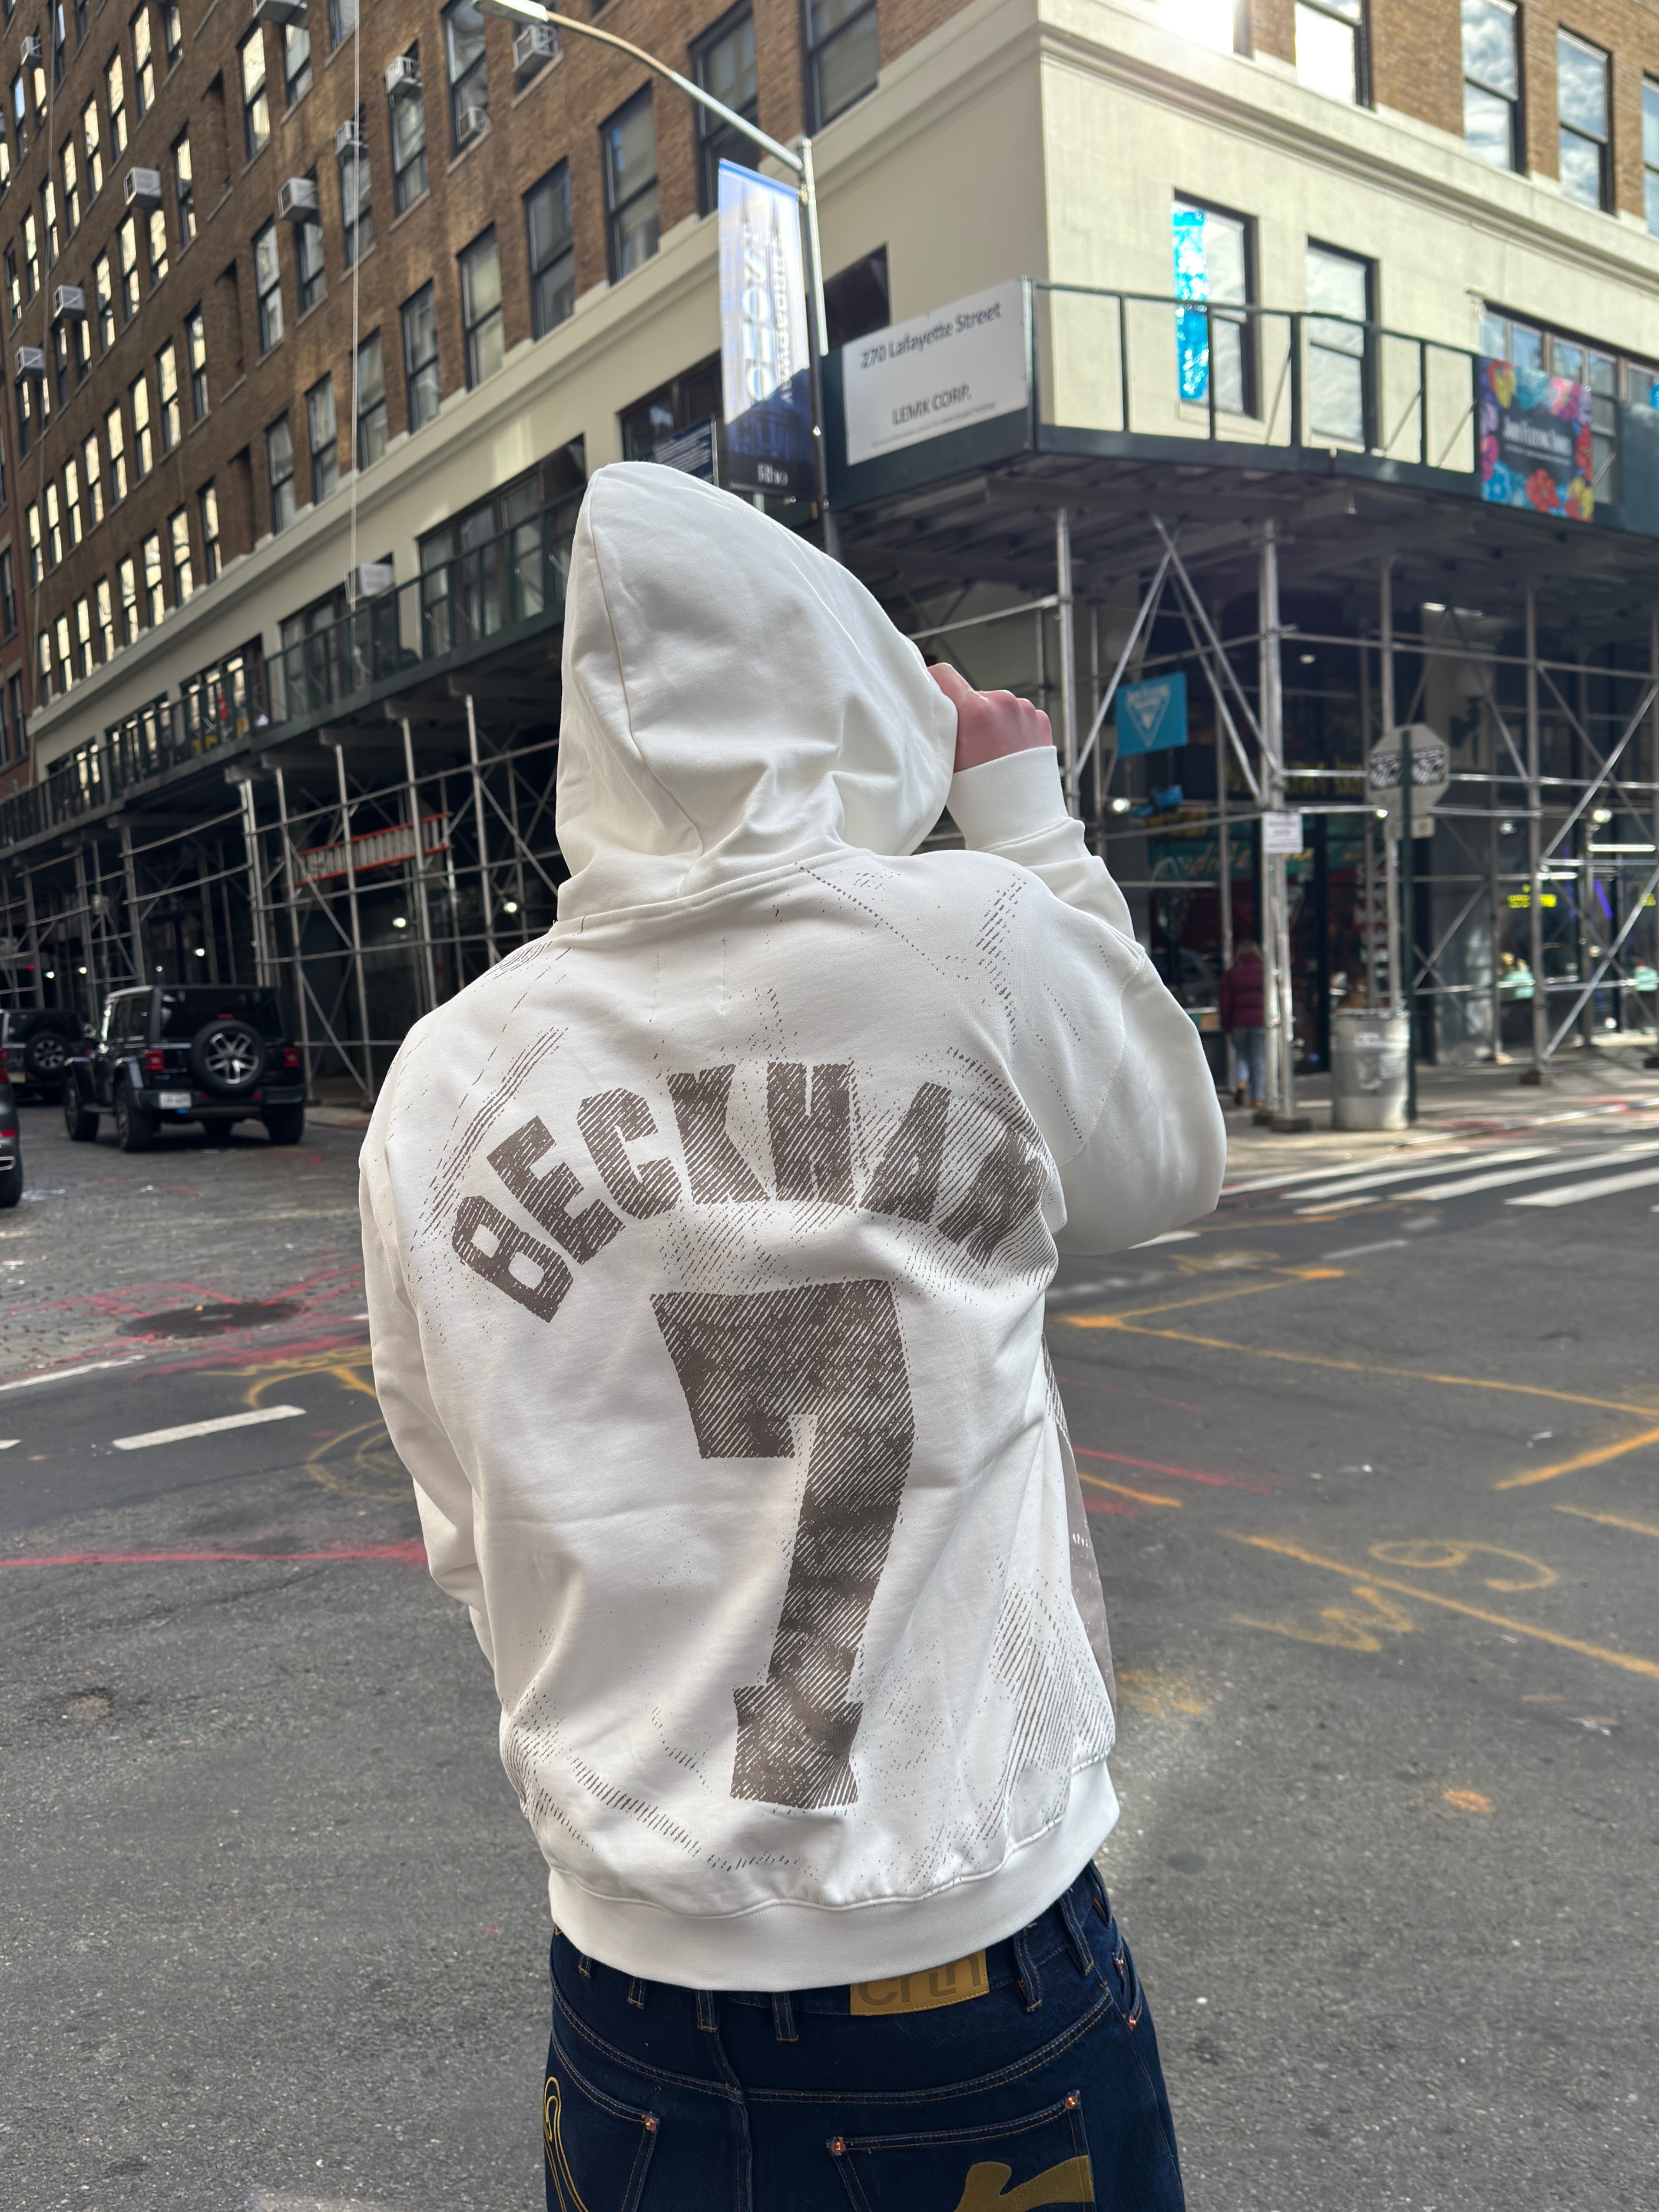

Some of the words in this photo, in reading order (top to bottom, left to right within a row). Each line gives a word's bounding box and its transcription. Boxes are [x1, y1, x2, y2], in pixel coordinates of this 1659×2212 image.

[860, 345, 888, 369] 270
[888, 322, 954, 358] Lafayette
[955, 302, 1002, 333] Street
[931, 384, 972, 411] CORP.
[757, 462, 788, 486] Rho
[650, 1279, 915, 1809] 7
